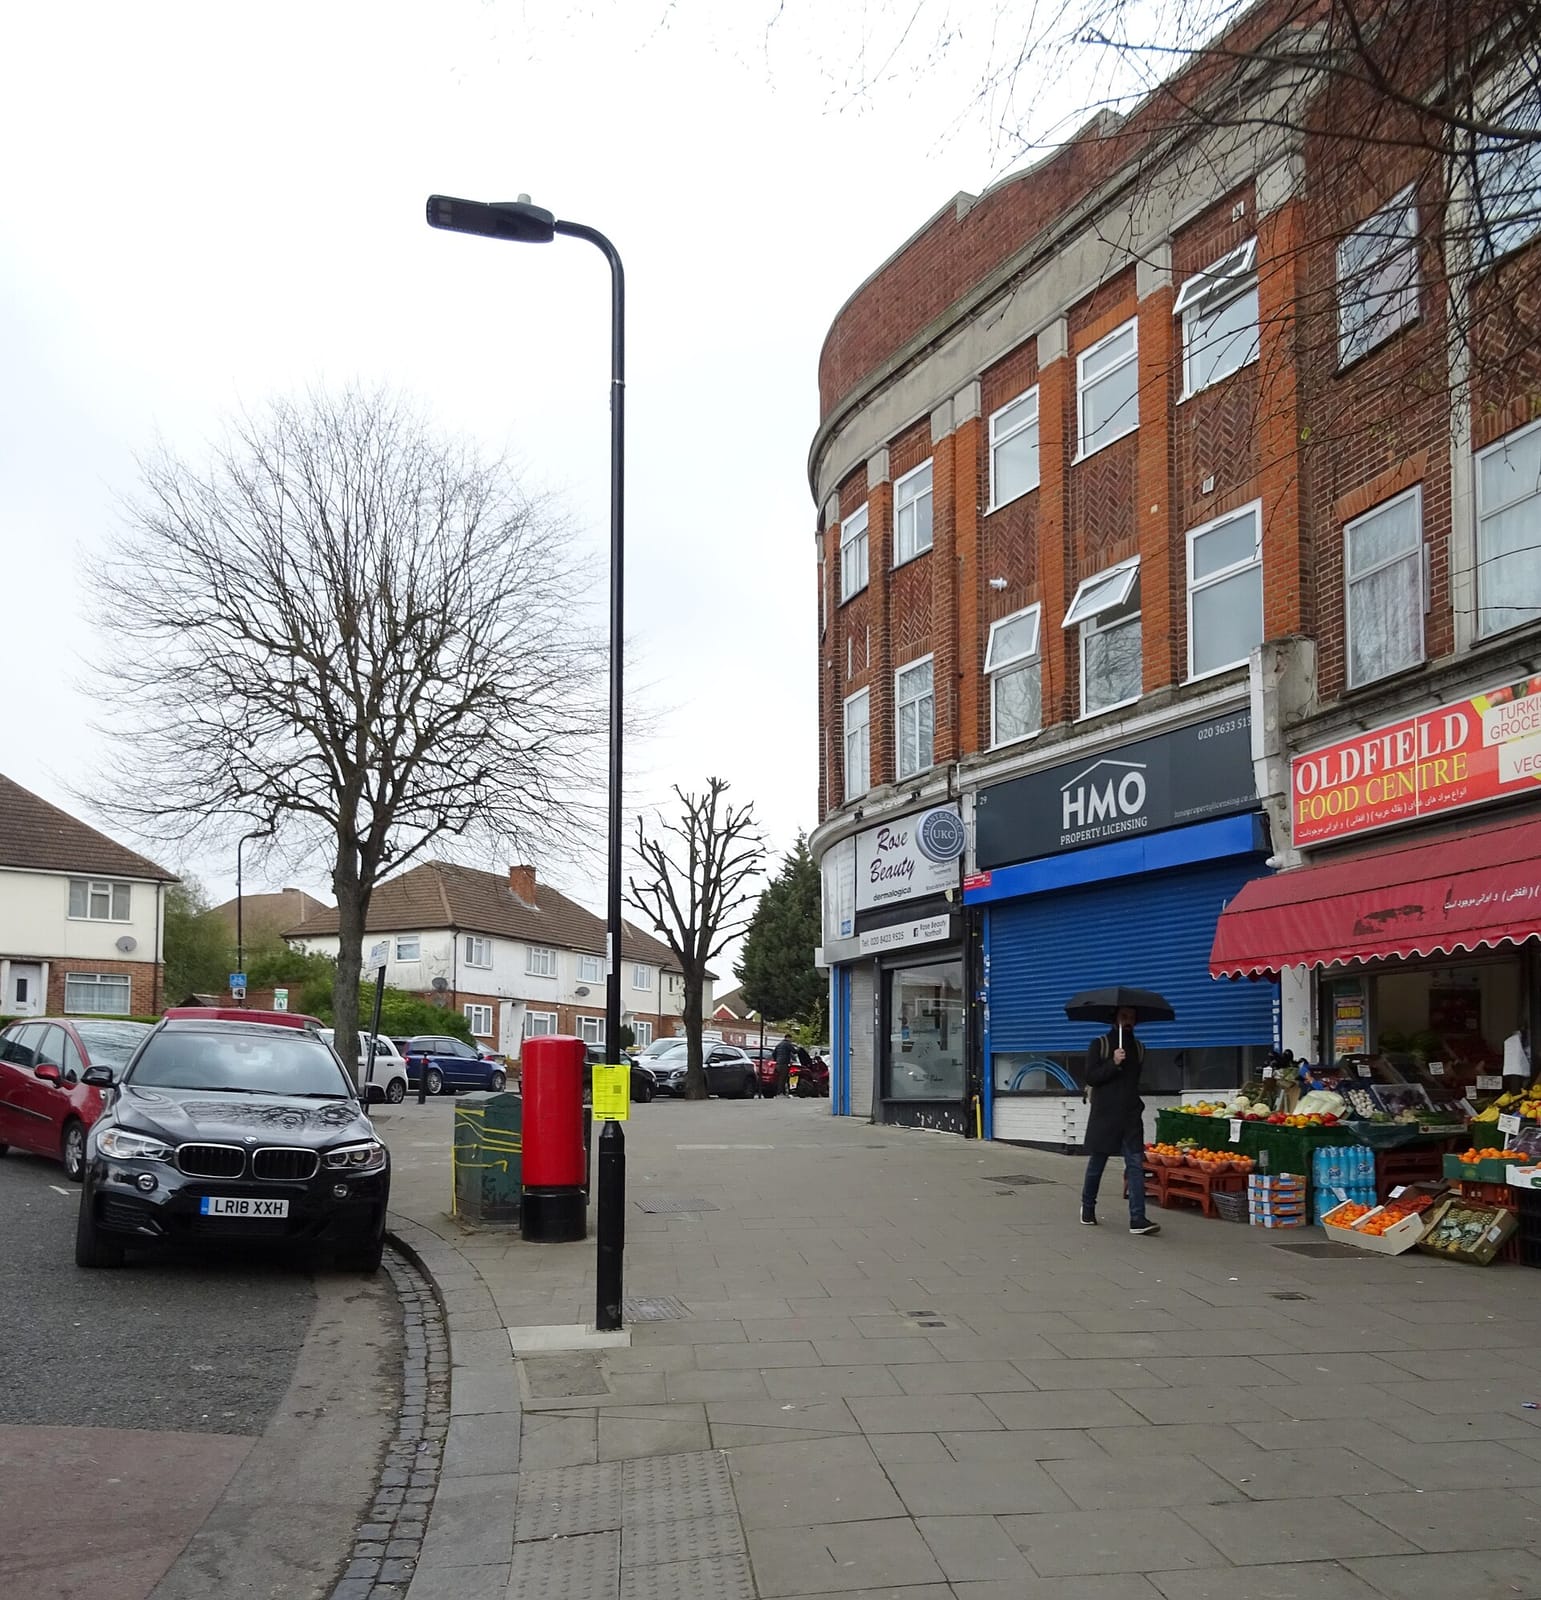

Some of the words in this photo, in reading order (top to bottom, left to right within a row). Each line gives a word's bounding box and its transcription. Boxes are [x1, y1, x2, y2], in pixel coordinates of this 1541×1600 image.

[1498, 696, 1541, 721] TURKI
[1198, 727, 1214, 741] 020
[1215, 720, 1236, 736] 3633
[1295, 712, 1469, 795] OLDFIELD
[979, 796, 988, 805] 29
[1062, 771, 1147, 830] HMO
[1298, 785, 1360, 825] FOOD
[1365, 752, 1469, 805] CENTRE
[877, 827, 909, 855] Rose
[933, 829, 955, 840] UKC
[1060, 826, 1101, 846] PROPERTY
[1102, 816, 1148, 836] LICENSING
[870, 857, 915, 883] Beauty
[873, 886, 912, 902] dermalogica
[214, 1199, 249, 1214] LR18
[252, 1201, 283, 1215] XXH
